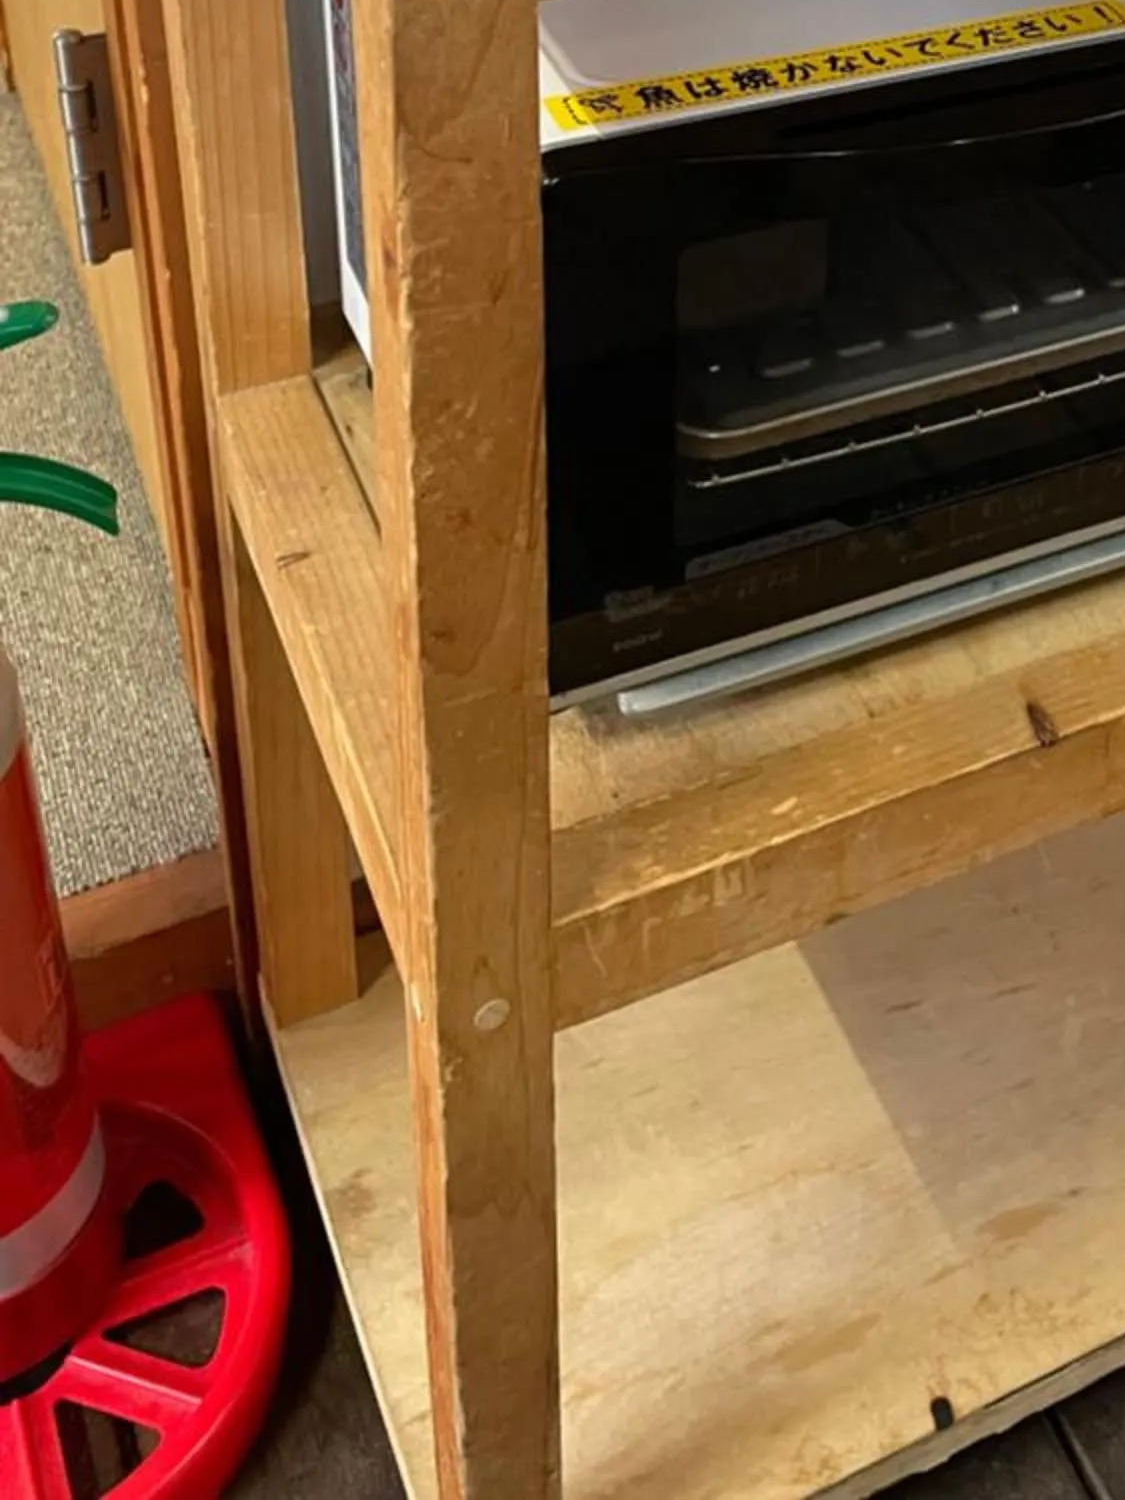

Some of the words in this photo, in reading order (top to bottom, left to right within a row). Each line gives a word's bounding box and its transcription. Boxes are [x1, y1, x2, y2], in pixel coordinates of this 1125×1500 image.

[635, 4, 1114, 110] 魚は焼かないでください！
